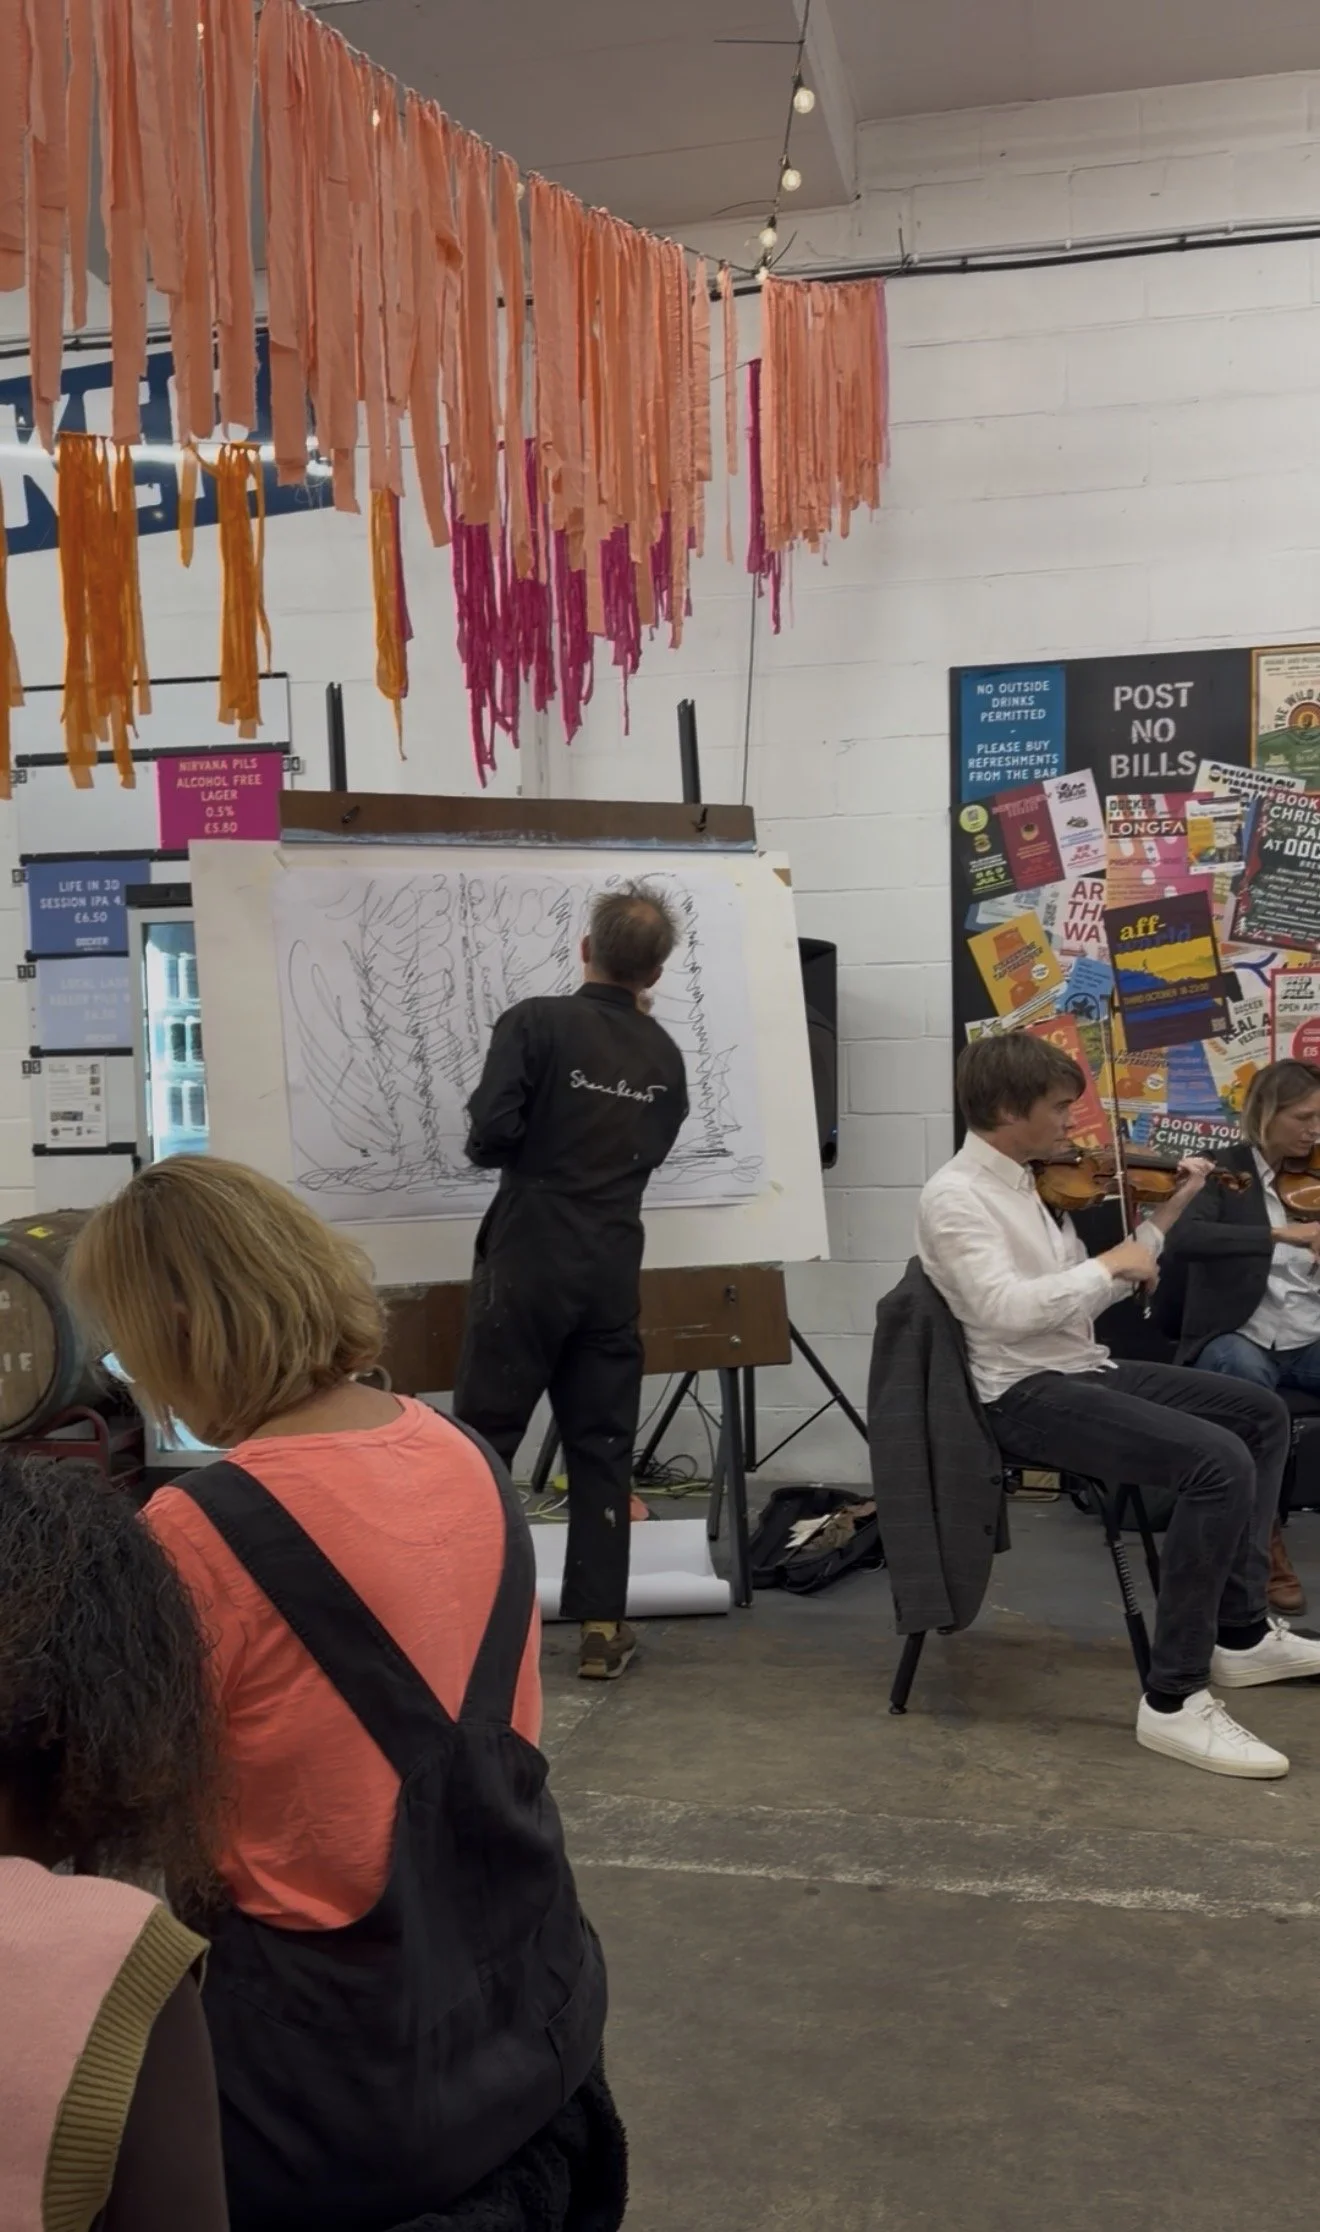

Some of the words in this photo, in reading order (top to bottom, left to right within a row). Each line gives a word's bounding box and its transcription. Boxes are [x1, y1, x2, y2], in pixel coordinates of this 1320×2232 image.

[977, 684, 994, 695] NO
[999, 681, 1050, 693] OUTSIDE
[992, 696, 1035, 708] DRINKS
[1113, 681, 1195, 712] POST
[981, 709, 1047, 722] PERMITTED
[1131, 717, 1176, 745] NO
[977, 741, 1021, 754] PLEASE
[1026, 740, 1050, 751] BUY
[178, 760, 228, 773] NIRVANA
[232, 758, 258, 770] PILS
[968, 754, 1059, 769] REFRESHMENTS
[1109, 750, 1197, 780] BILLS
[969, 770, 1000, 781] FROM
[1006, 769, 1029, 779] THE
[1034, 767, 1058, 779] BAR
[176, 776, 228, 789] ALCOHOL
[233, 774, 263, 786] FREE
[201, 790, 238, 802] LAGER
[1276, 792, 1320, 810] BOOK
[205, 806, 235, 818] 0.5%
[1263, 840, 1284, 852] AT
[59, 880, 83, 892] LIFE
[88, 880, 100, 891] IN
[40, 897, 87, 909] SESSION
[91, 896, 109, 908] IPA
[74, 911, 108, 923] £6.50
[1160, 1118, 1204, 1134] BOOK
